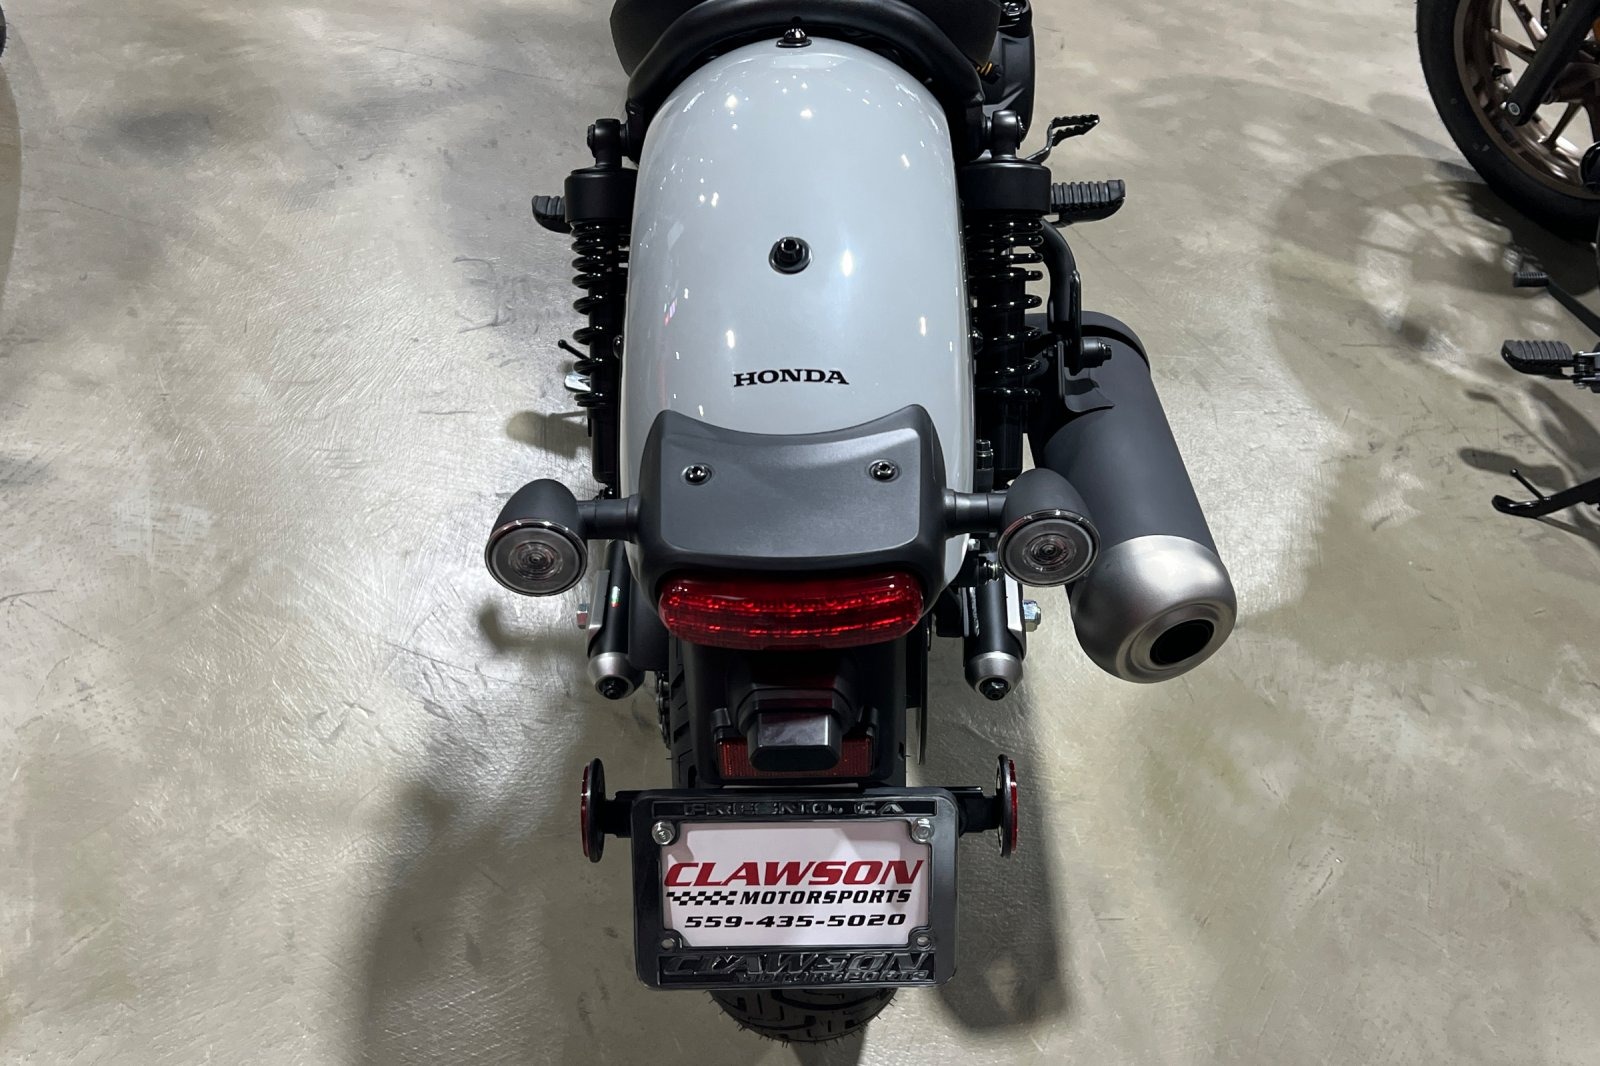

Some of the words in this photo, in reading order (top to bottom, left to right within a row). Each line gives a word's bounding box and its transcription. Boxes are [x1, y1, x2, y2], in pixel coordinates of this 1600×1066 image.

[733, 368, 850, 387] HONDA
[853, 800, 905, 816] CA
[664, 859, 924, 887] CLAWSON
[739, 889, 912, 905] MOTORSPORTS
[684, 913, 906, 928] 559-435-5020
[663, 952, 928, 975] CLAWSON
[737, 970, 930, 983] OPORTS
